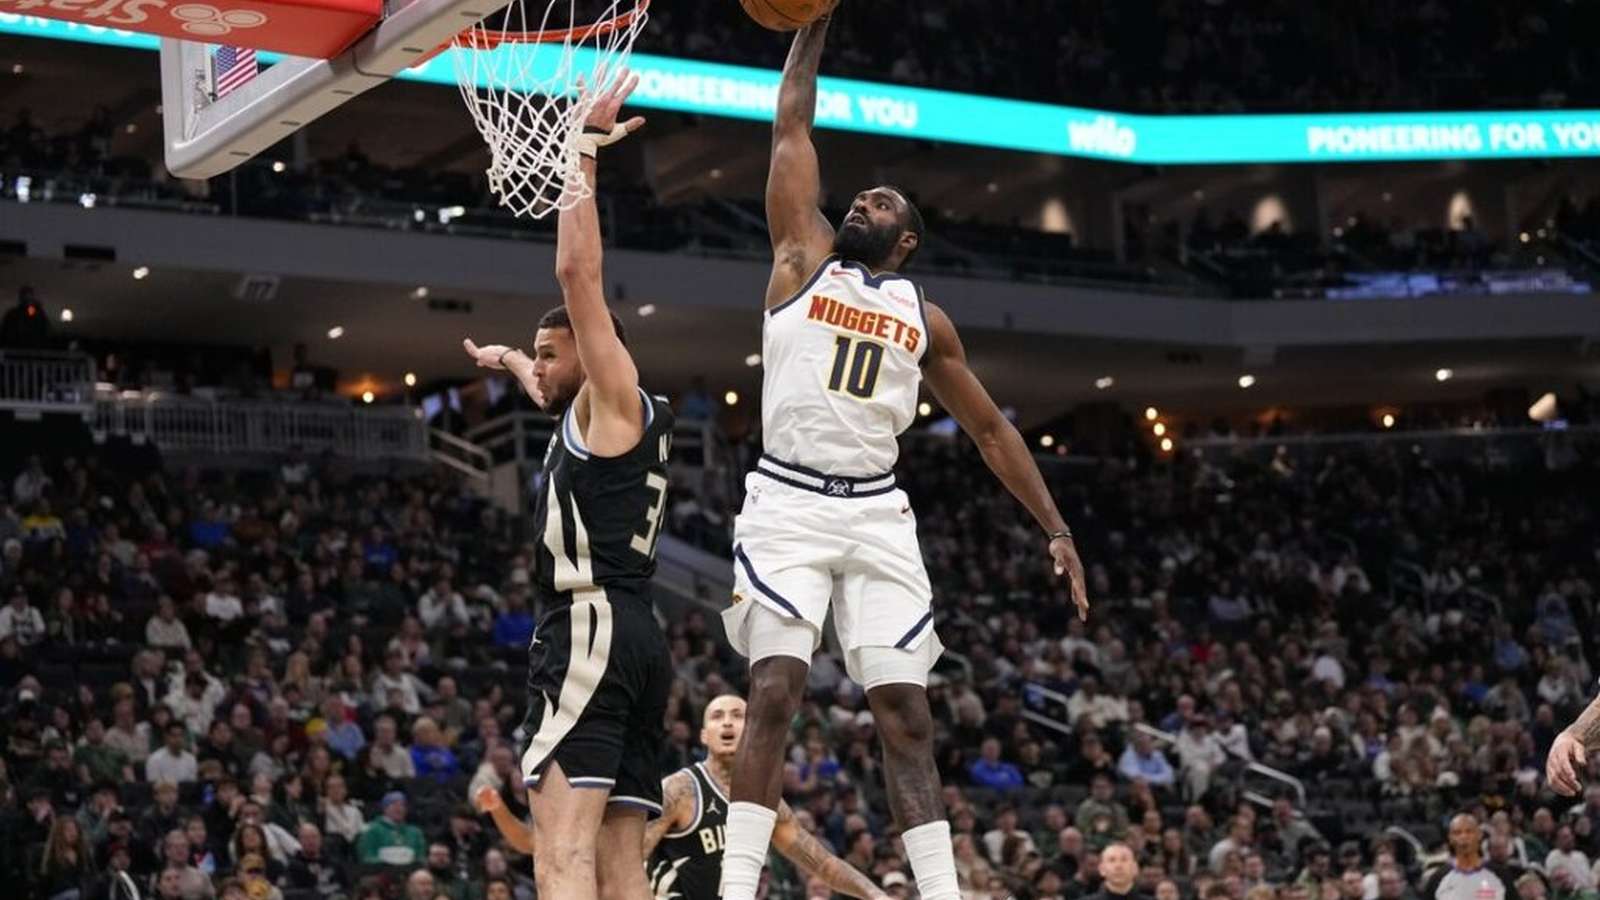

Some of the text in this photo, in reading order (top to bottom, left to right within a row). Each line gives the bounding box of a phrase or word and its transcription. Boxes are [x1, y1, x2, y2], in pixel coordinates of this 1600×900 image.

[616, 69, 918, 128] IONEERIN OR YOU
[1307, 124, 1483, 152] PIONEERING
[1488, 123, 1546, 150] FOR
[807, 294, 921, 354] NUGGETS
[828, 335, 885, 399] 10
[629, 471, 669, 560] 3
